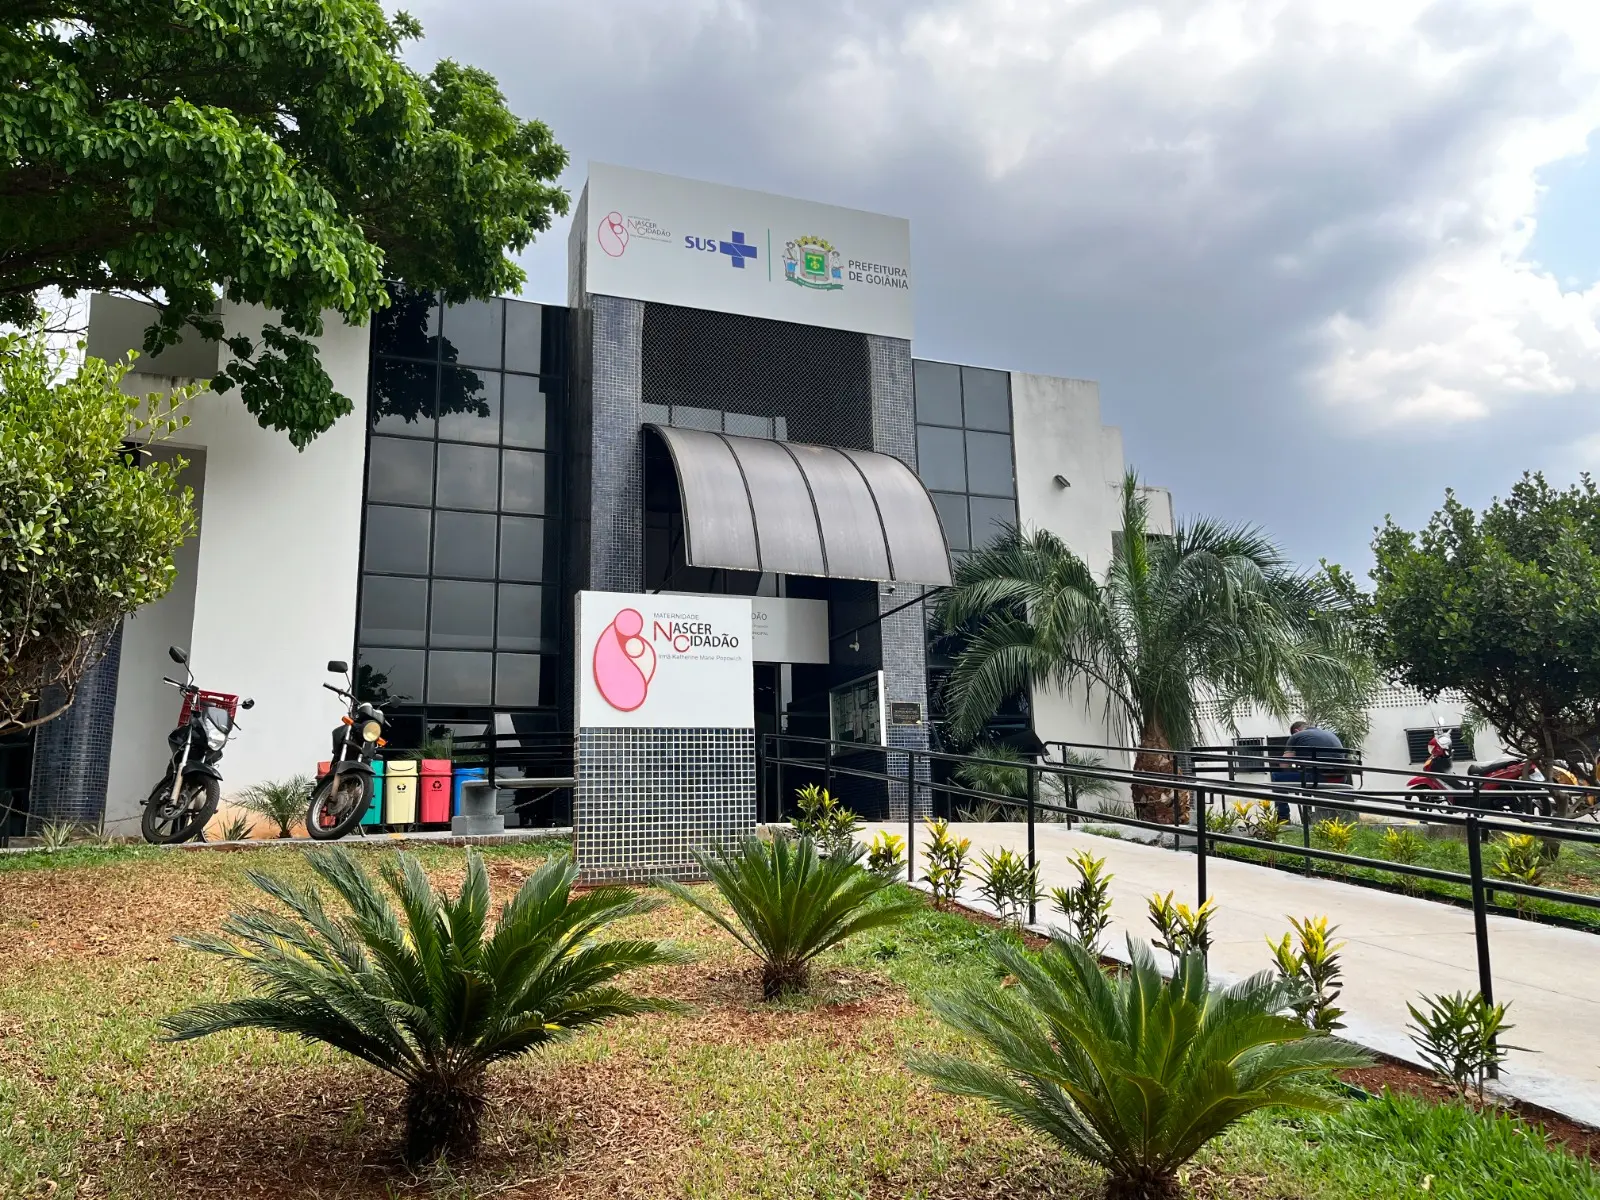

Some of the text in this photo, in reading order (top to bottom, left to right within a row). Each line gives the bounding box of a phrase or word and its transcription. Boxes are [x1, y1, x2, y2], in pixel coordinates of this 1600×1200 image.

[628, 218, 657, 229] NASCER
[637, 226, 671, 237] CIDADÃO
[684, 235, 717, 252] SUS
[848, 260, 908, 277] PREFEITURA
[848, 271, 909, 289] DE GOIÂNIA
[653, 612, 700, 620] MATERNIDADE
[653, 621, 712, 642] NASCER
[673, 633, 739, 653] CIDADÃO
